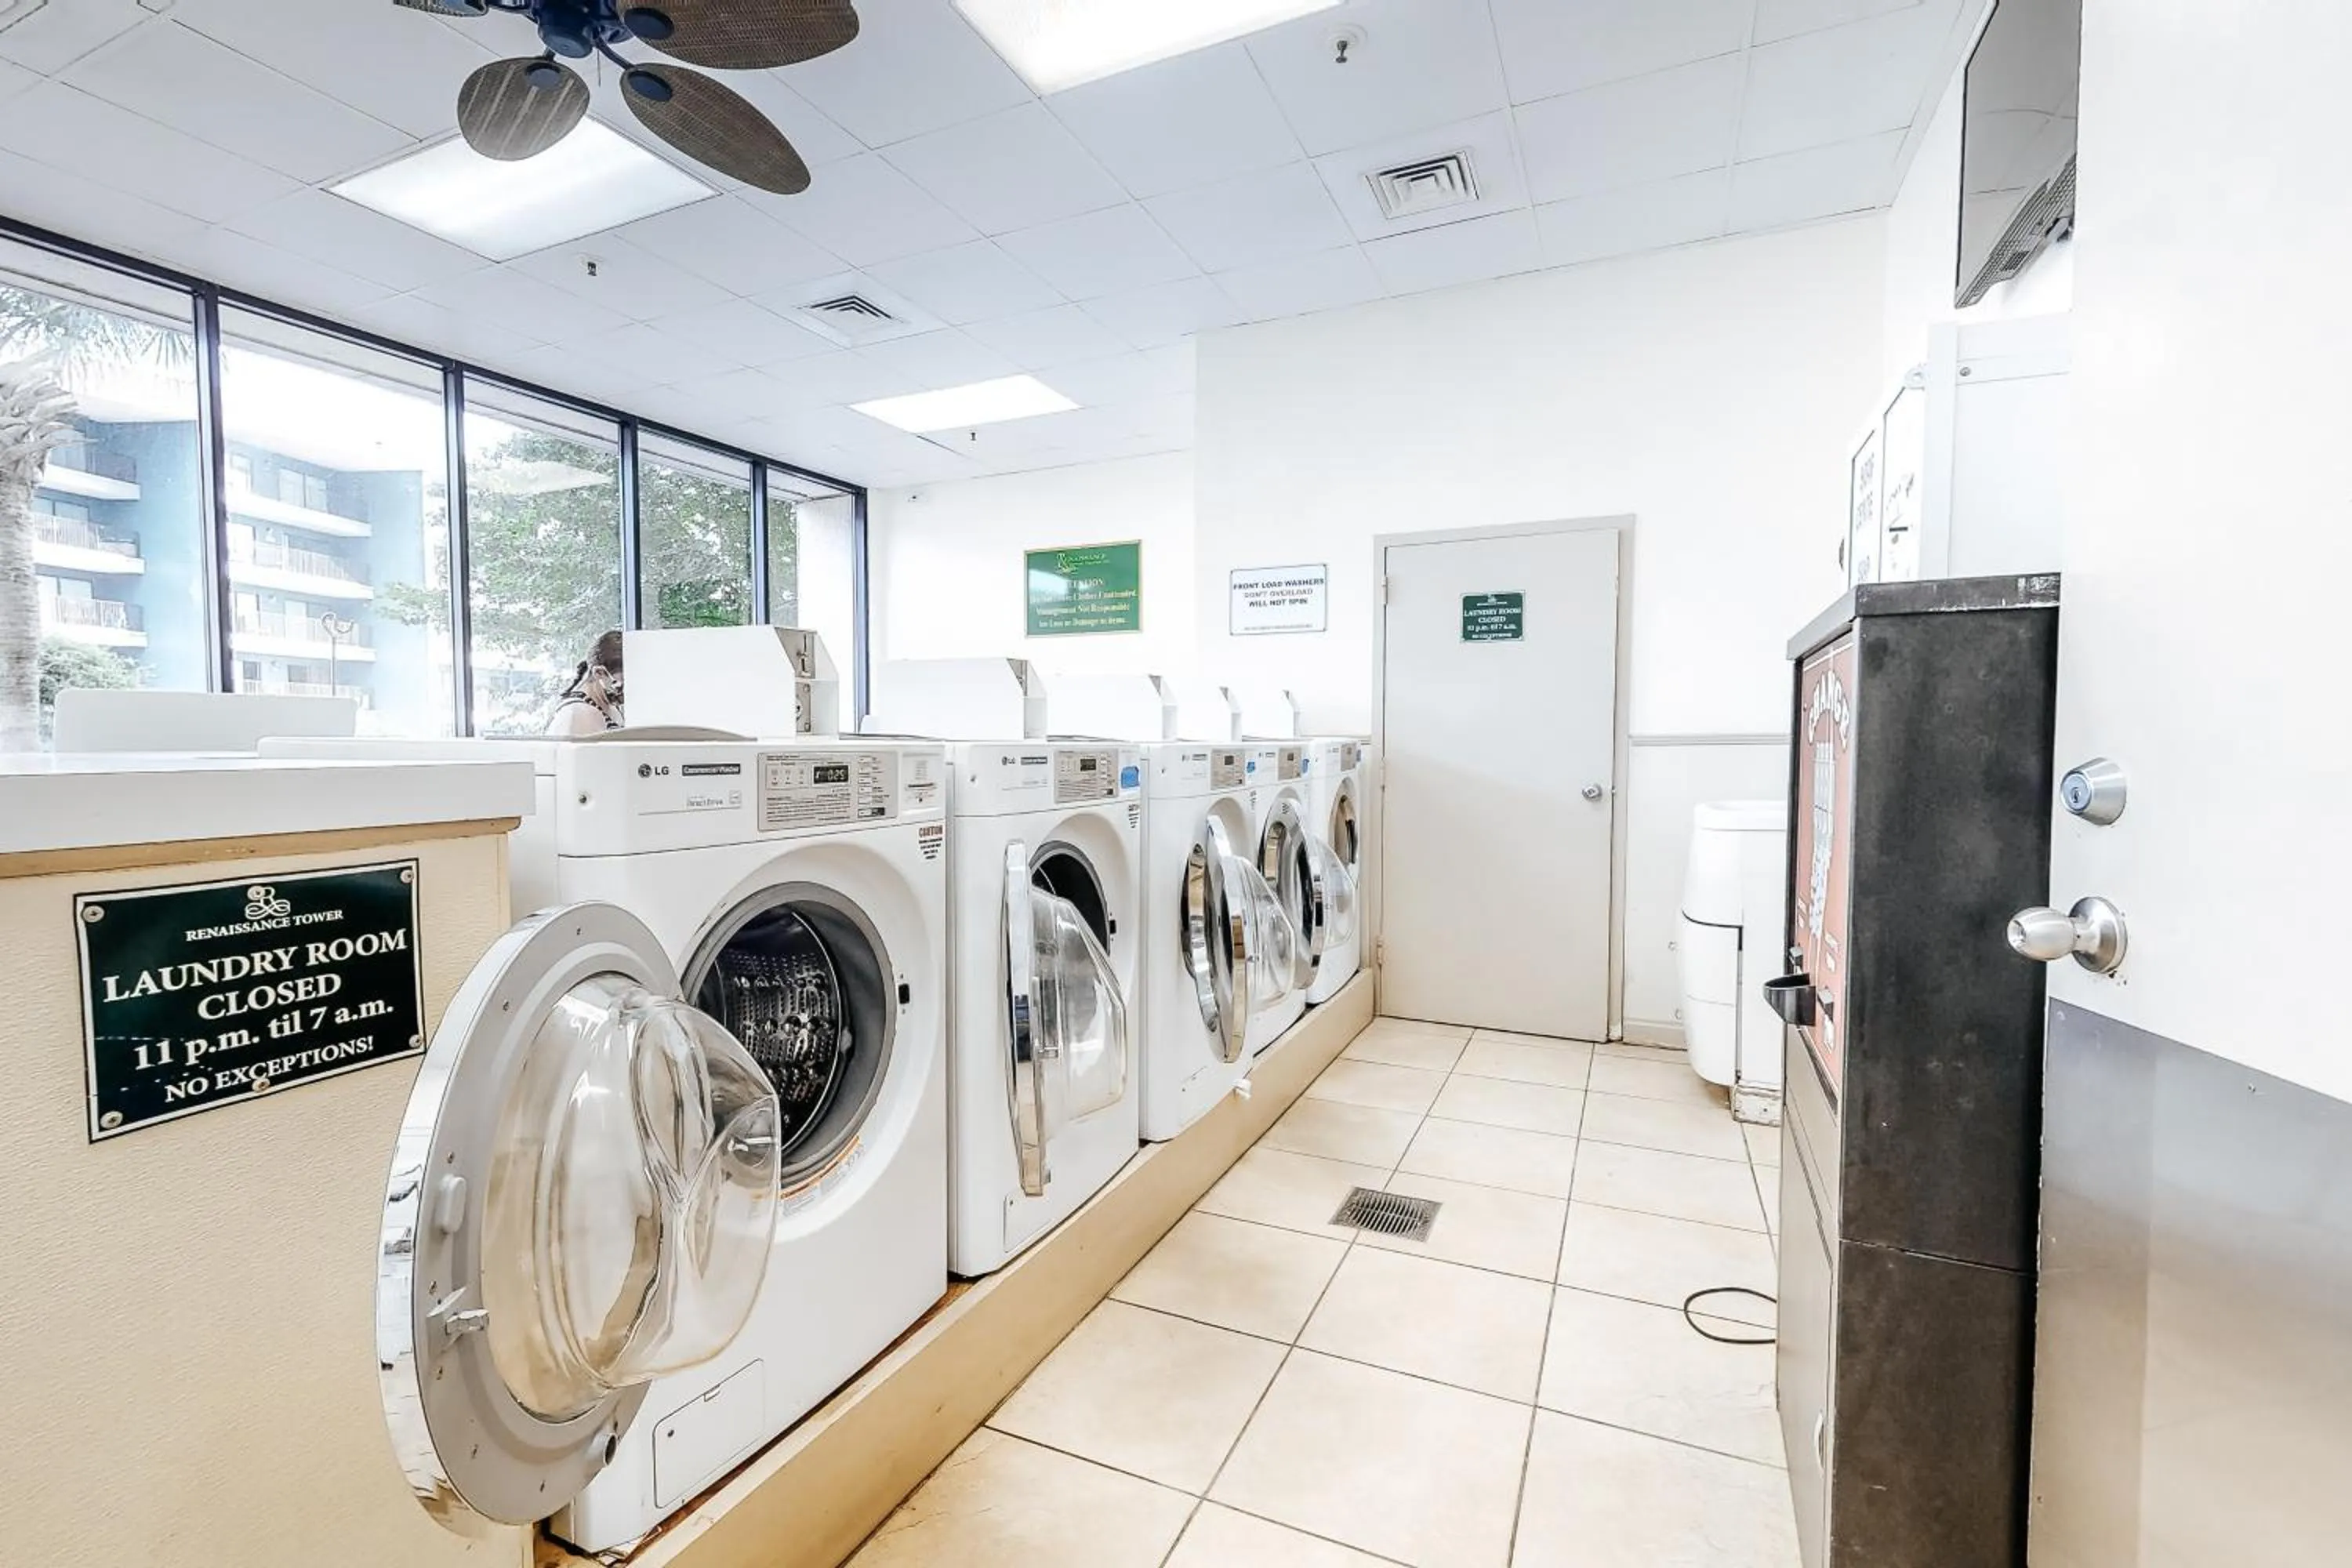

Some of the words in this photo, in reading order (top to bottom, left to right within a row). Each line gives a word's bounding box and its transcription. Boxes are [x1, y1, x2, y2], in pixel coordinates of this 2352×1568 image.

[1284, 578, 1324, 587] WASHERS
[655, 766, 670, 775] LG
[186, 917, 291, 942] RENAISSANCE
[294, 909, 343, 927] TOWER
[102, 946, 299, 1003] LAUNDRY
[306, 928, 408, 967] ROOM
[198, 972, 342, 1020] CLOSED
[133, 1041, 175, 1070] 11
[184, 1031, 260, 1065] p.m.
[267, 1013, 303, 1040] til
[309, 1007, 328, 1029] 7
[335, 998, 394, 1025] a.m.
[163, 1077, 209, 1103] NO
[215, 1035, 375, 1090] EXCEPTIONS!
